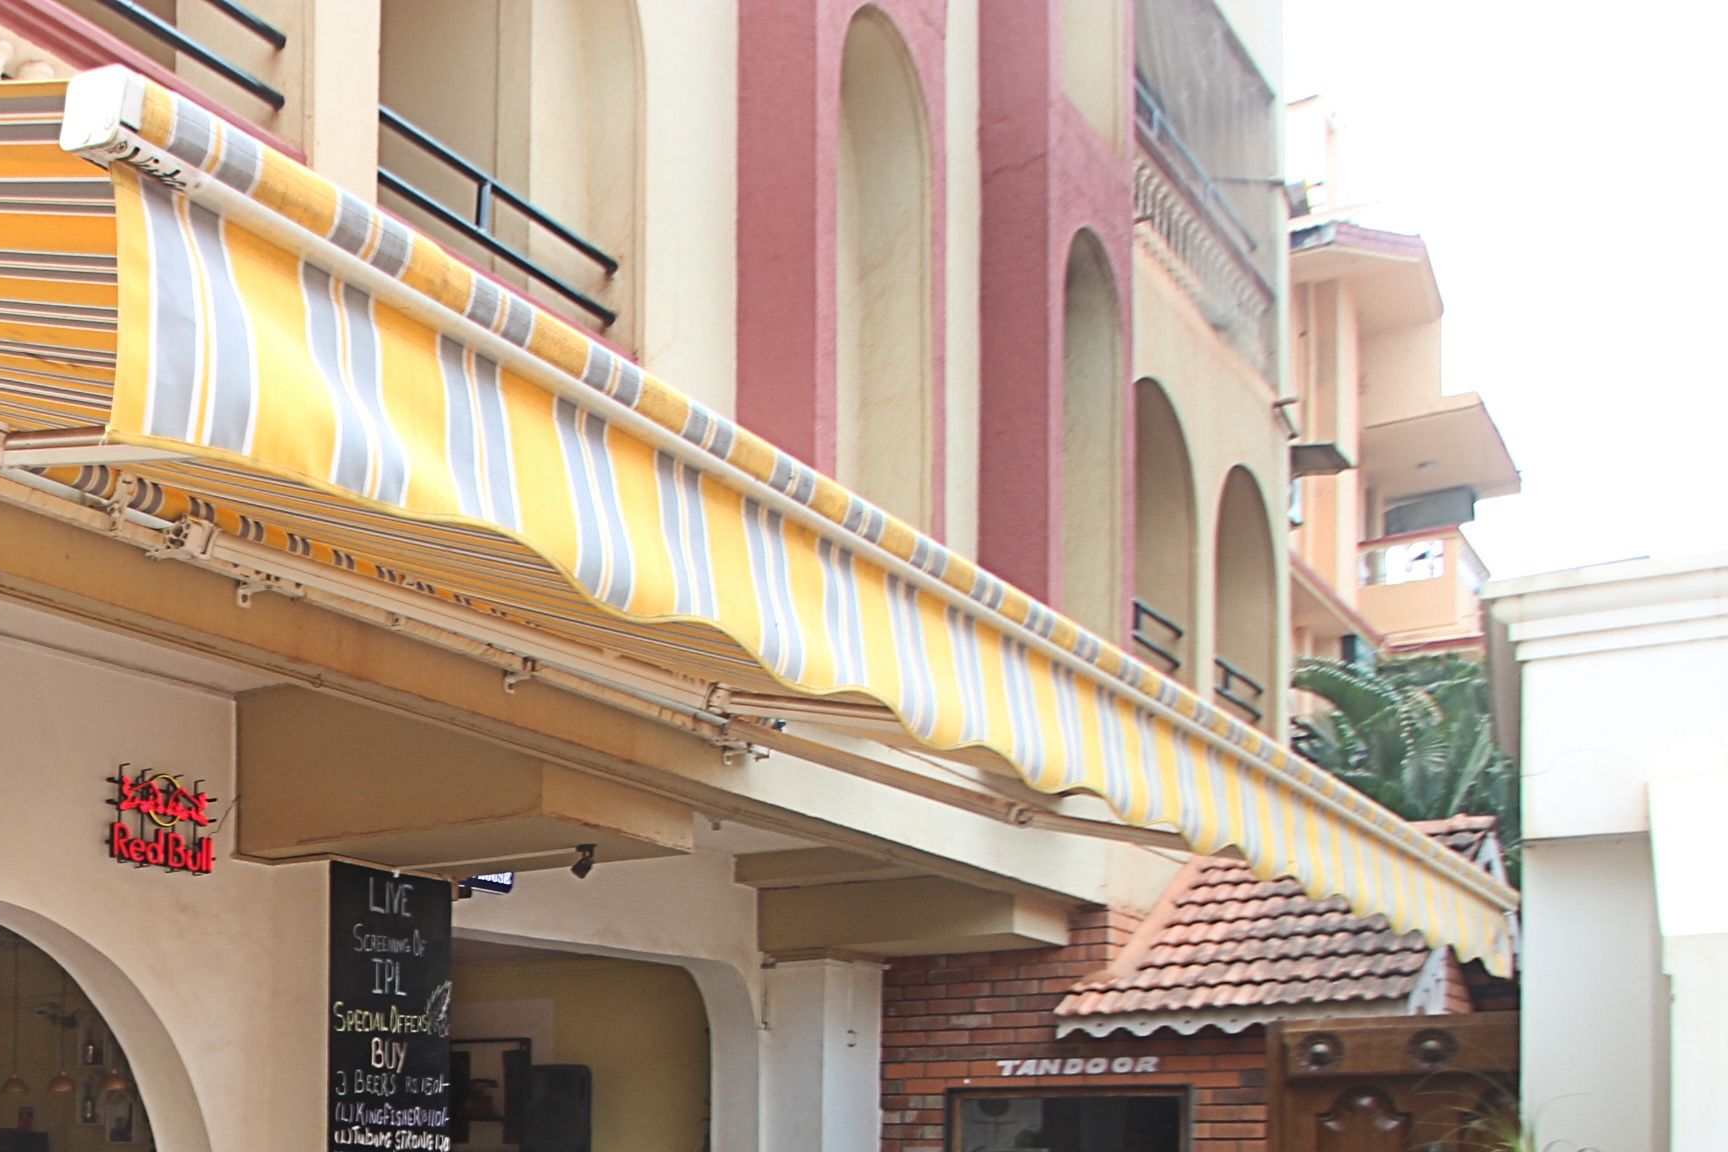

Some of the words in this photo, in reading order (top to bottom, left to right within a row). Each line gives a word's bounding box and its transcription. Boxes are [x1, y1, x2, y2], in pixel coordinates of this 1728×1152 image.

[113, 821, 165, 864] Red
[168, 832, 213, 873] Bull
[368, 876, 414, 917] LIVE
[353, 923, 411, 954] SCREENING
[412, 929, 427, 957] OF
[371, 957, 407, 996] IPL
[333, 1001, 388, 1032] SPECIAL
[371, 1037, 407, 1074] BUY
[996, 1055, 1161, 1077] TANDOOR
[335, 1071, 348, 1096] 3
[353, 1069, 398, 1097] BEERS
[355, 1102, 421, 1127] KINGFISHER
